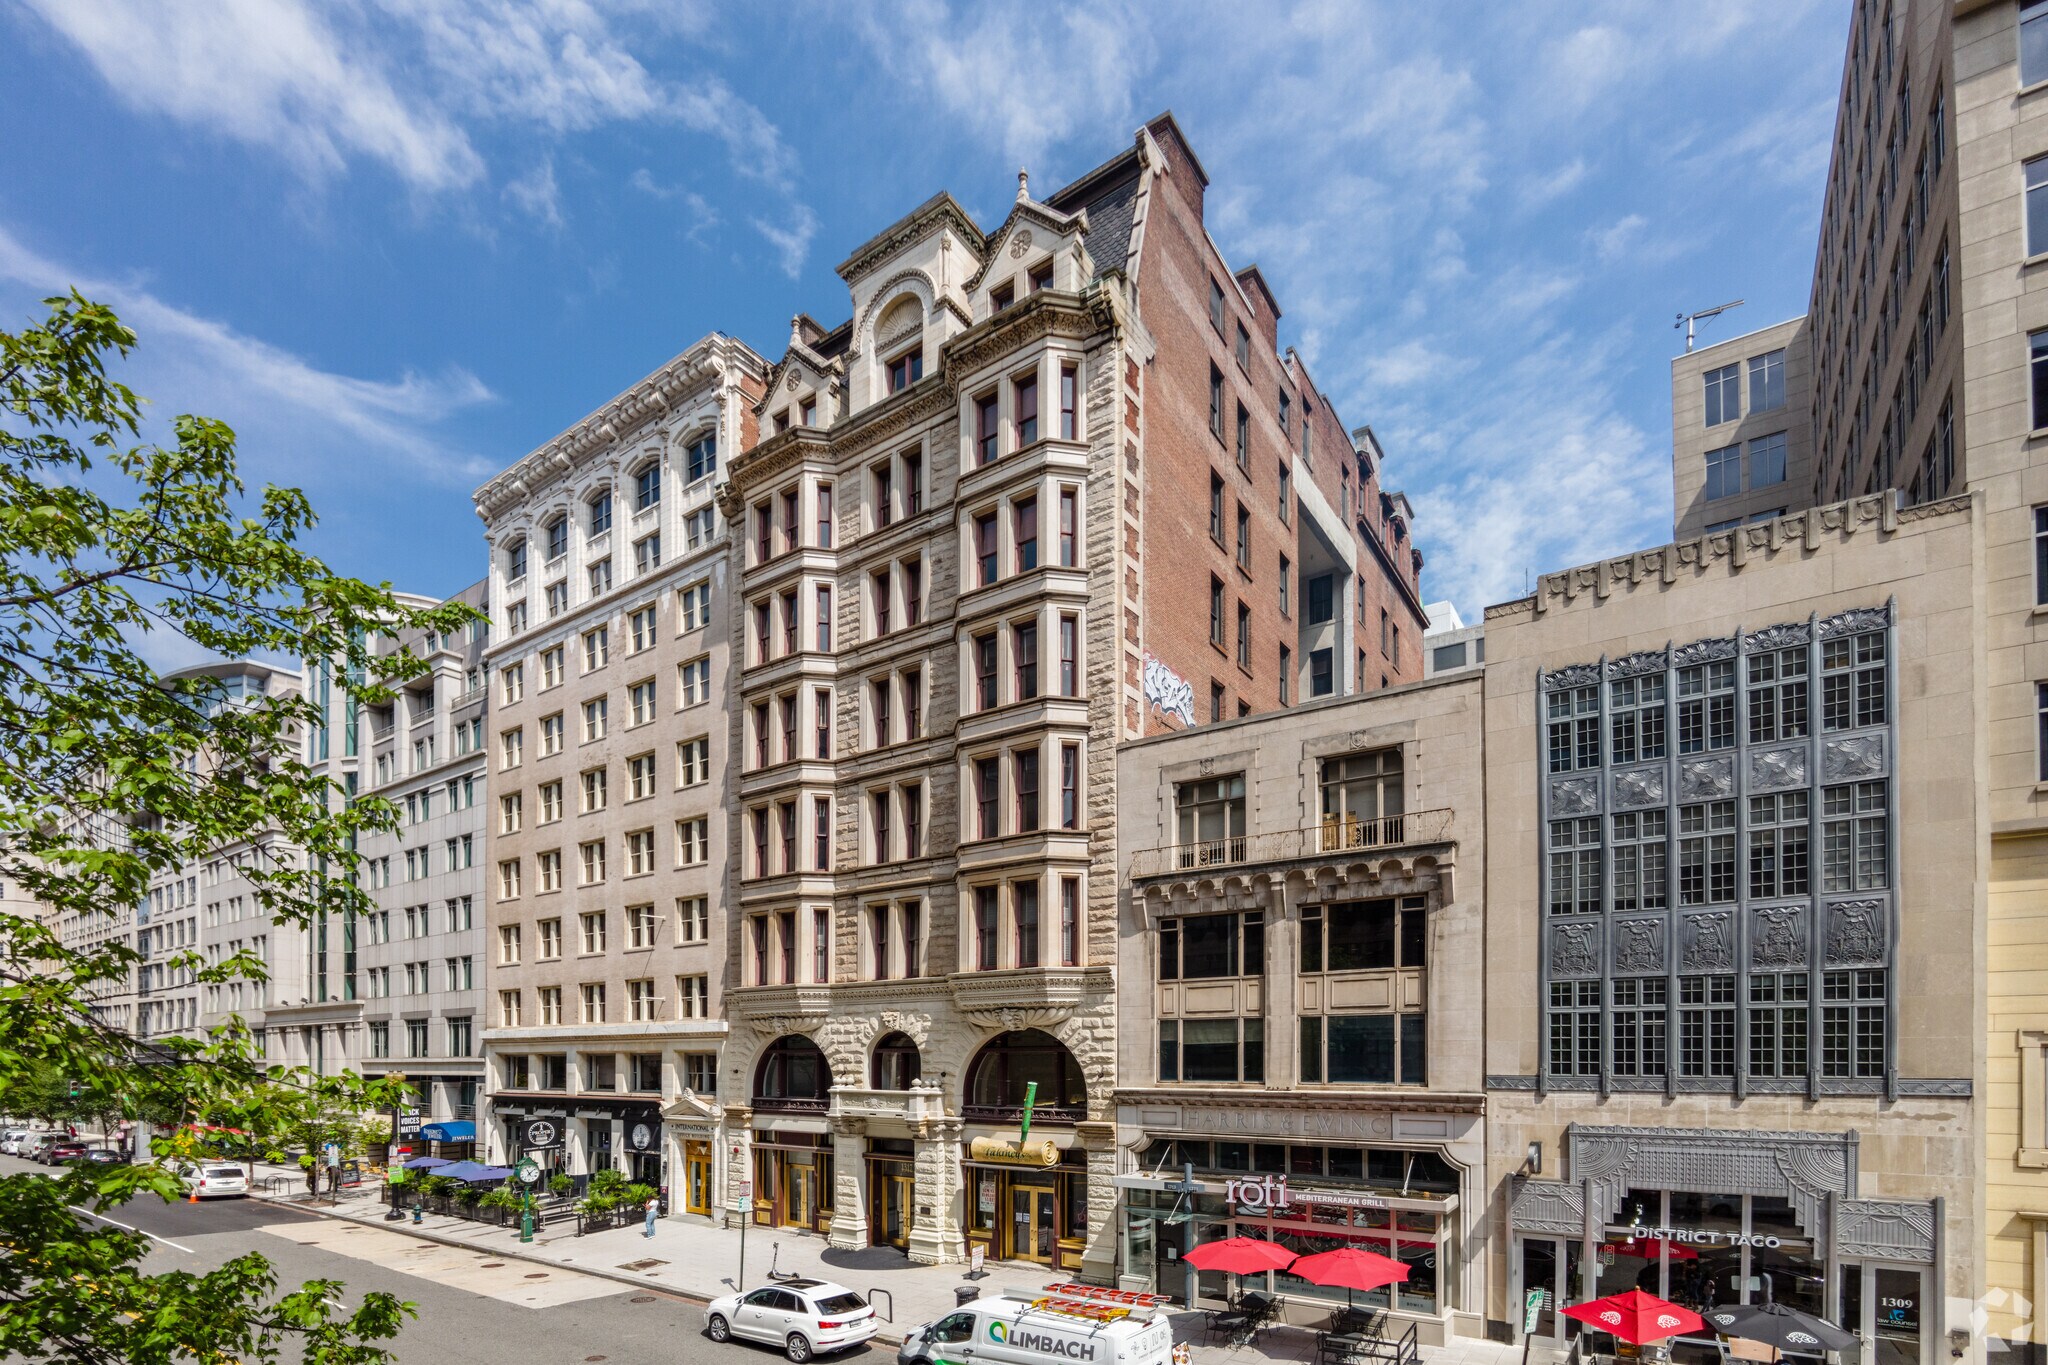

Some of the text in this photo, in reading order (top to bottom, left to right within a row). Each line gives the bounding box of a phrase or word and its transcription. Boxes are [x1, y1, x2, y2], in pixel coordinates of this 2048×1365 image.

[400, 1125, 420, 1133] MATTER
[675, 1123, 709, 1132] INTERNATIONAL
[1186, 1112, 1387, 1134] HARRIS & EWING
[1296, 1194, 1384, 1207] MEDITERRANEAN GRILL
[1726, 1234, 1780, 1248] TACO
[1881, 1297, 1913, 1308] 1309
[1009, 1330, 1095, 1361] LIMBACH
